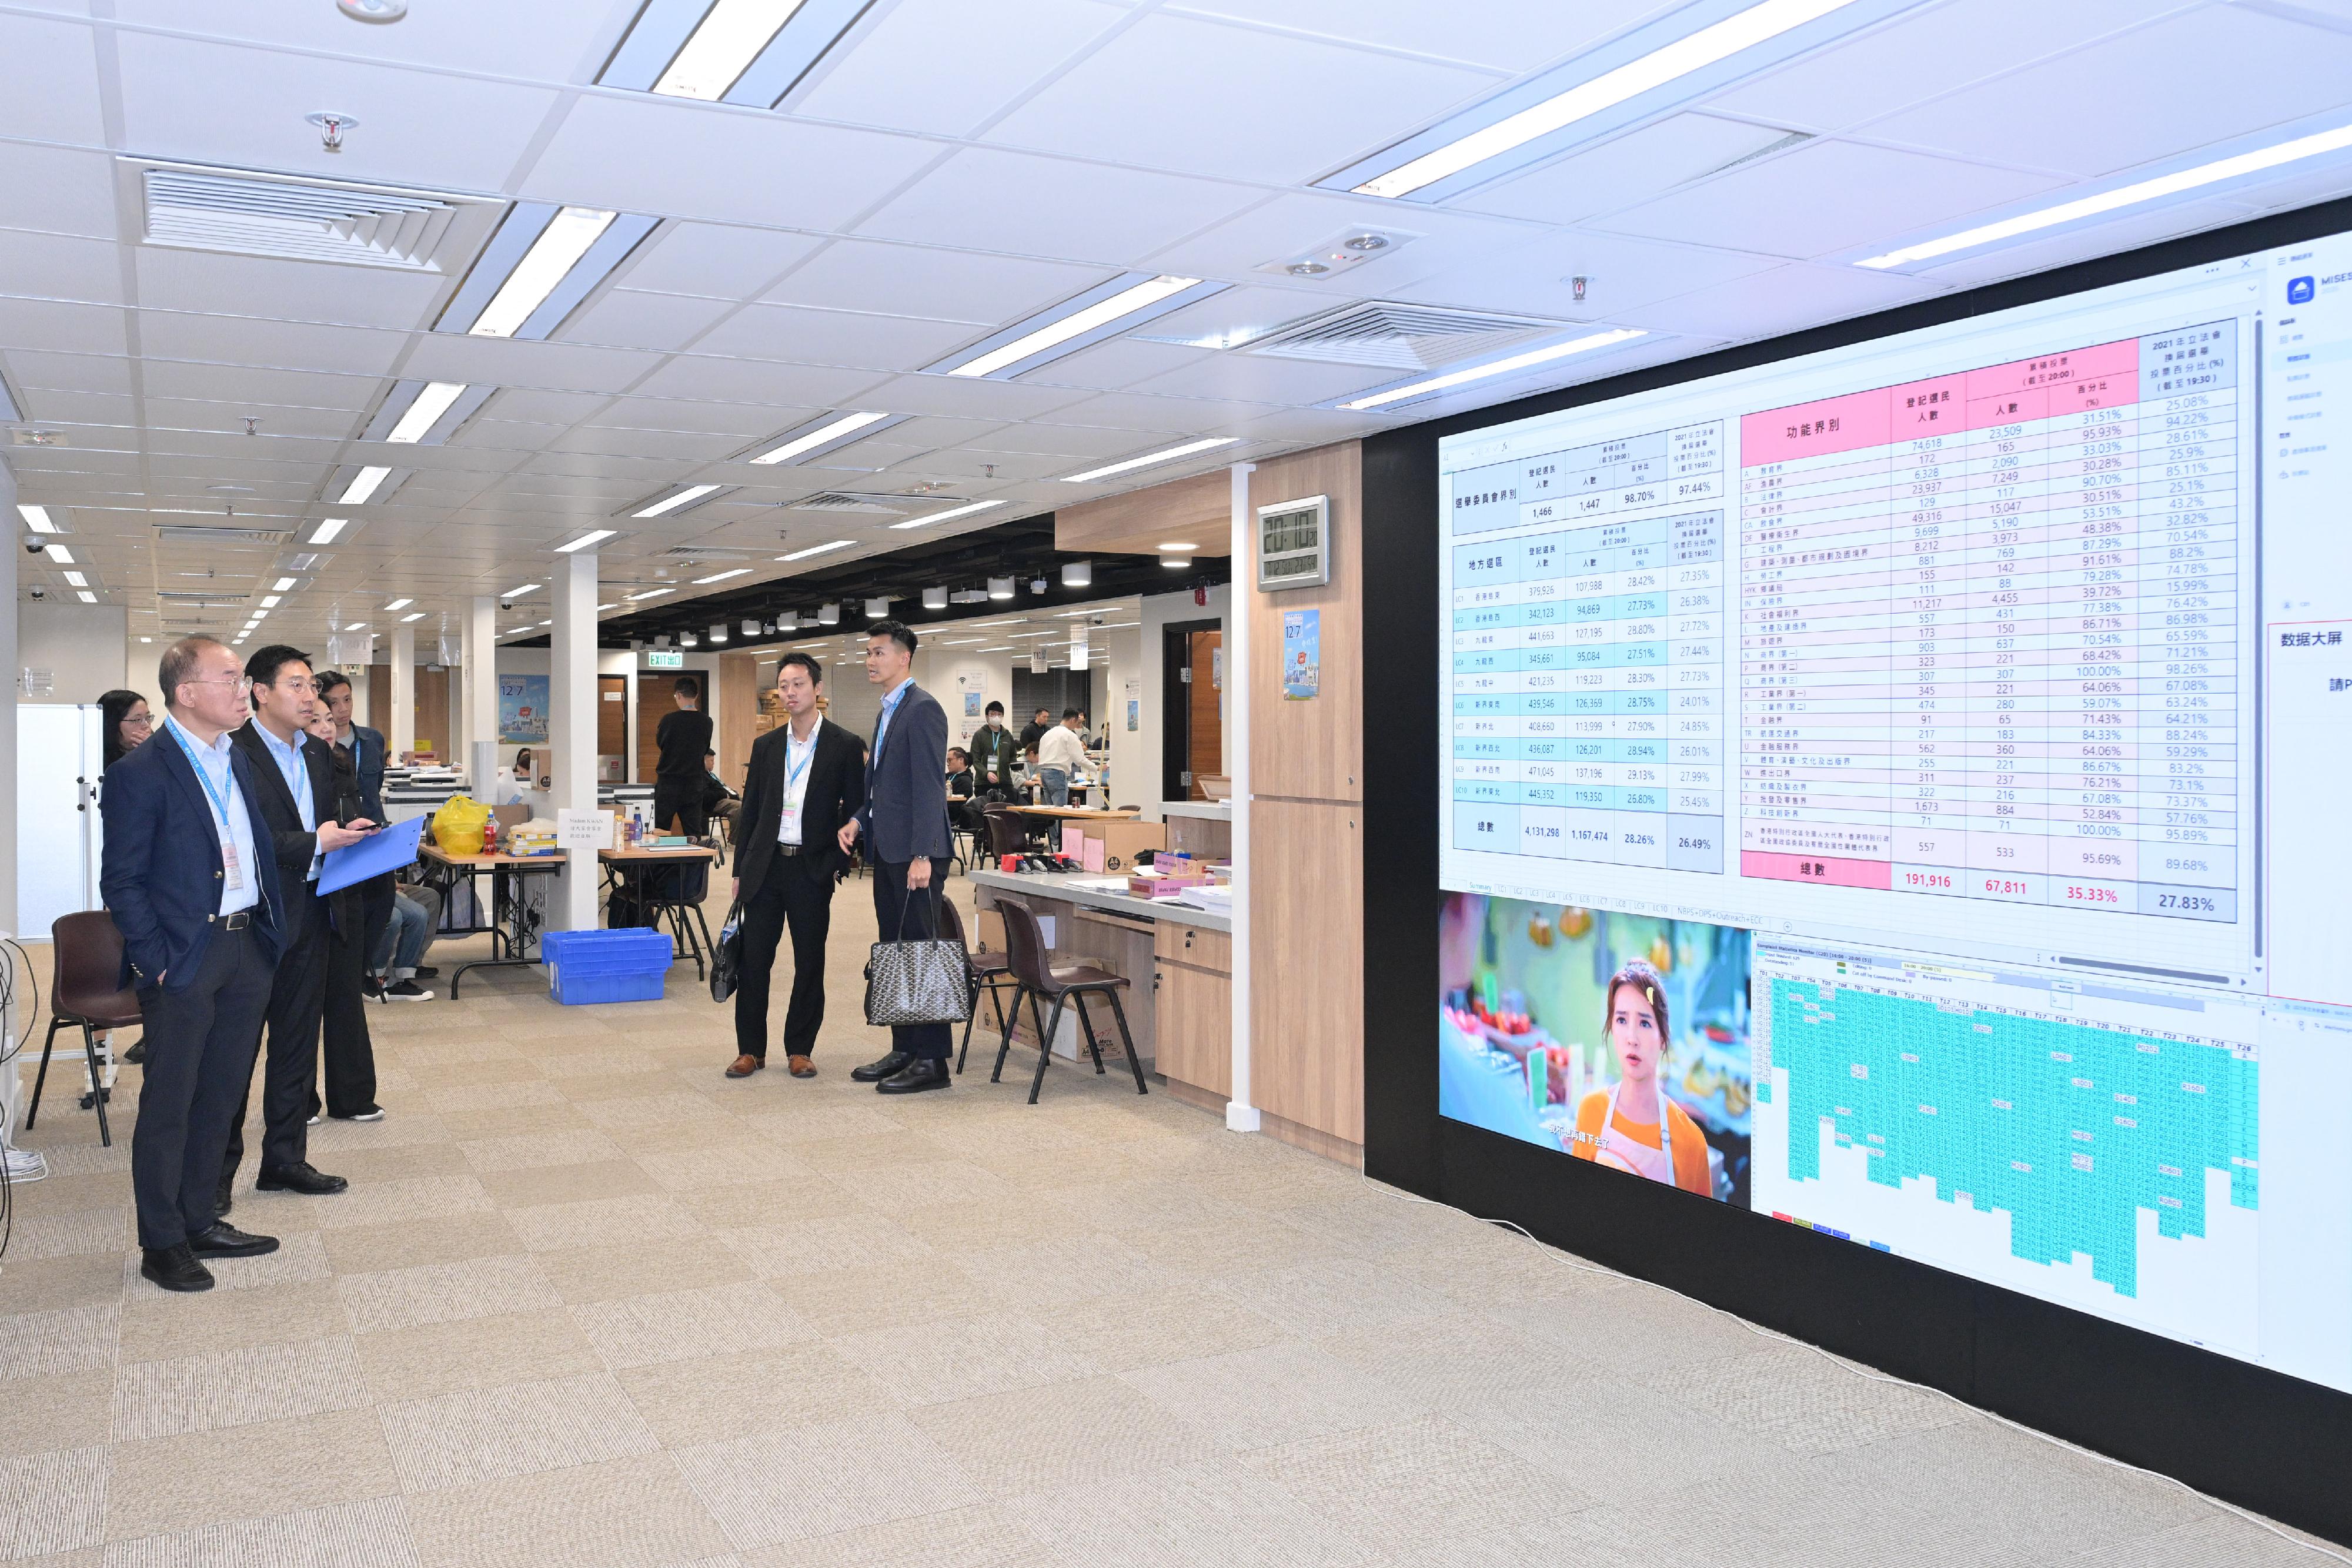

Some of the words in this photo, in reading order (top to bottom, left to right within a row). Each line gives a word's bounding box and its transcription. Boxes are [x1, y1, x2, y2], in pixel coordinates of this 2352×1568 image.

[1787, 417, 1840, 439] 功能界別
[1912, 439, 1942, 452] 74,618
[1989, 426, 2022, 439] 23,509
[2083, 409, 2122, 424] 31.51%
[2166, 396, 2208, 411] 25.08%
[1455, 487, 1517, 509] 選舉委員會界別
[1533, 506, 1552, 518] 1,466
[1580, 499, 1600, 510] 1,447
[1625, 490, 1654, 503] 98.70%
[1679, 482, 1710, 495] 97.44%
[1469, 556, 1503, 570] 地方選區
[1529, 585, 1554, 596] 379,926
[1576, 580, 1602, 591] 107,988
[1628, 576, 1654, 587] 28.42%
[1681, 569, 1709, 581] 27.35%
[1913, 599, 1942, 610] 11,217
[1992, 593, 2018, 604] 4,455
[2083, 586, 2122, 598] 39.72%
[2167, 579, 2208, 592] 15.99%
[1529, 608, 1554, 619] 342,123
[1577, 604, 1600, 616] 94,869
[1628, 600, 1655, 611] 27.73%
[1681, 594, 1709, 607] 26.38%
[2281, 631, 2342, 647] 数据大屏
[651, 656, 667, 665] EXIT
[668, 656, 680, 665] 出口
[1529, 653, 1553, 664] 345,661
[1577, 651, 1600, 661] 95,084
[1628, 648, 1655, 660] 27.51%
[1681, 645, 1709, 657] 27.44%
[1529, 698, 1554, 710] 439,546
[1576, 697, 1602, 708] 126,369
[1628, 697, 1655, 708] 28.75%
[1681, 696, 1709, 707] 24.01%
[1529, 721, 1554, 732] 408,660
[1576, 721, 1602, 732] 113,999
[1628, 721, 1655, 732] 27.90%
[1681, 721, 1709, 732] 24.85%
[1921, 715, 1932, 724] 91
[1999, 715, 2010, 724] 65
[2083, 714, 2121, 724] 71.43%
[2166, 713, 2208, 724] 64.21%
[1529, 767, 1554, 777] 471,045
[1576, 768, 1602, 778] 137,196
[1628, 769, 1655, 781] 29.13%
[1681, 771, 1709, 783] 27.99%
[1529, 789, 1554, 800] 445,352
[1576, 791, 1602, 803] 119,350
[1628, 794, 1655, 805] 26.80%
[1681, 796, 1709, 808] 25.45%
[1915, 801, 1939, 813] 1,673
[1996, 805, 2014, 815] 884
[2083, 809, 2121, 820] 52.84%
[2166, 813, 2208, 825] 57.76%
[1478, 821, 1494, 833] 總數
[1525, 826, 1559, 839] 4,131,298
[1572, 830, 1608, 842] 1,167,474
[1625, 834, 1654, 846] 28.26%
[1679, 838, 1710, 850] 26.49%
[1919, 842, 1935, 852] 557
[1997, 847, 2014, 858] 533
[2083, 853, 2121, 865] 95.69%
[2166, 859, 2208, 871] 89.68%
[1469, 881, 1492, 892] Summary
[1546, 890, 1555, 898] LC4
[1563, 892, 1572, 901] LC5
[1598, 897, 1607, 905] LC7
[1616, 899, 1625, 908] LC8
[1634, 902, 1644, 910] LC9
[1653, 904, 1668, 912] LC10
[1800, 862, 1825, 877] 總數
[1906, 873, 1950, 888] 191,916
[1986, 880, 2026, 895] 67,811
[2067, 887, 2117, 903] 35.33%
[2159, 895, 2214, 911] 27.83%
[1549, 1123, 1610, 1149] 我不想再錯下去了
